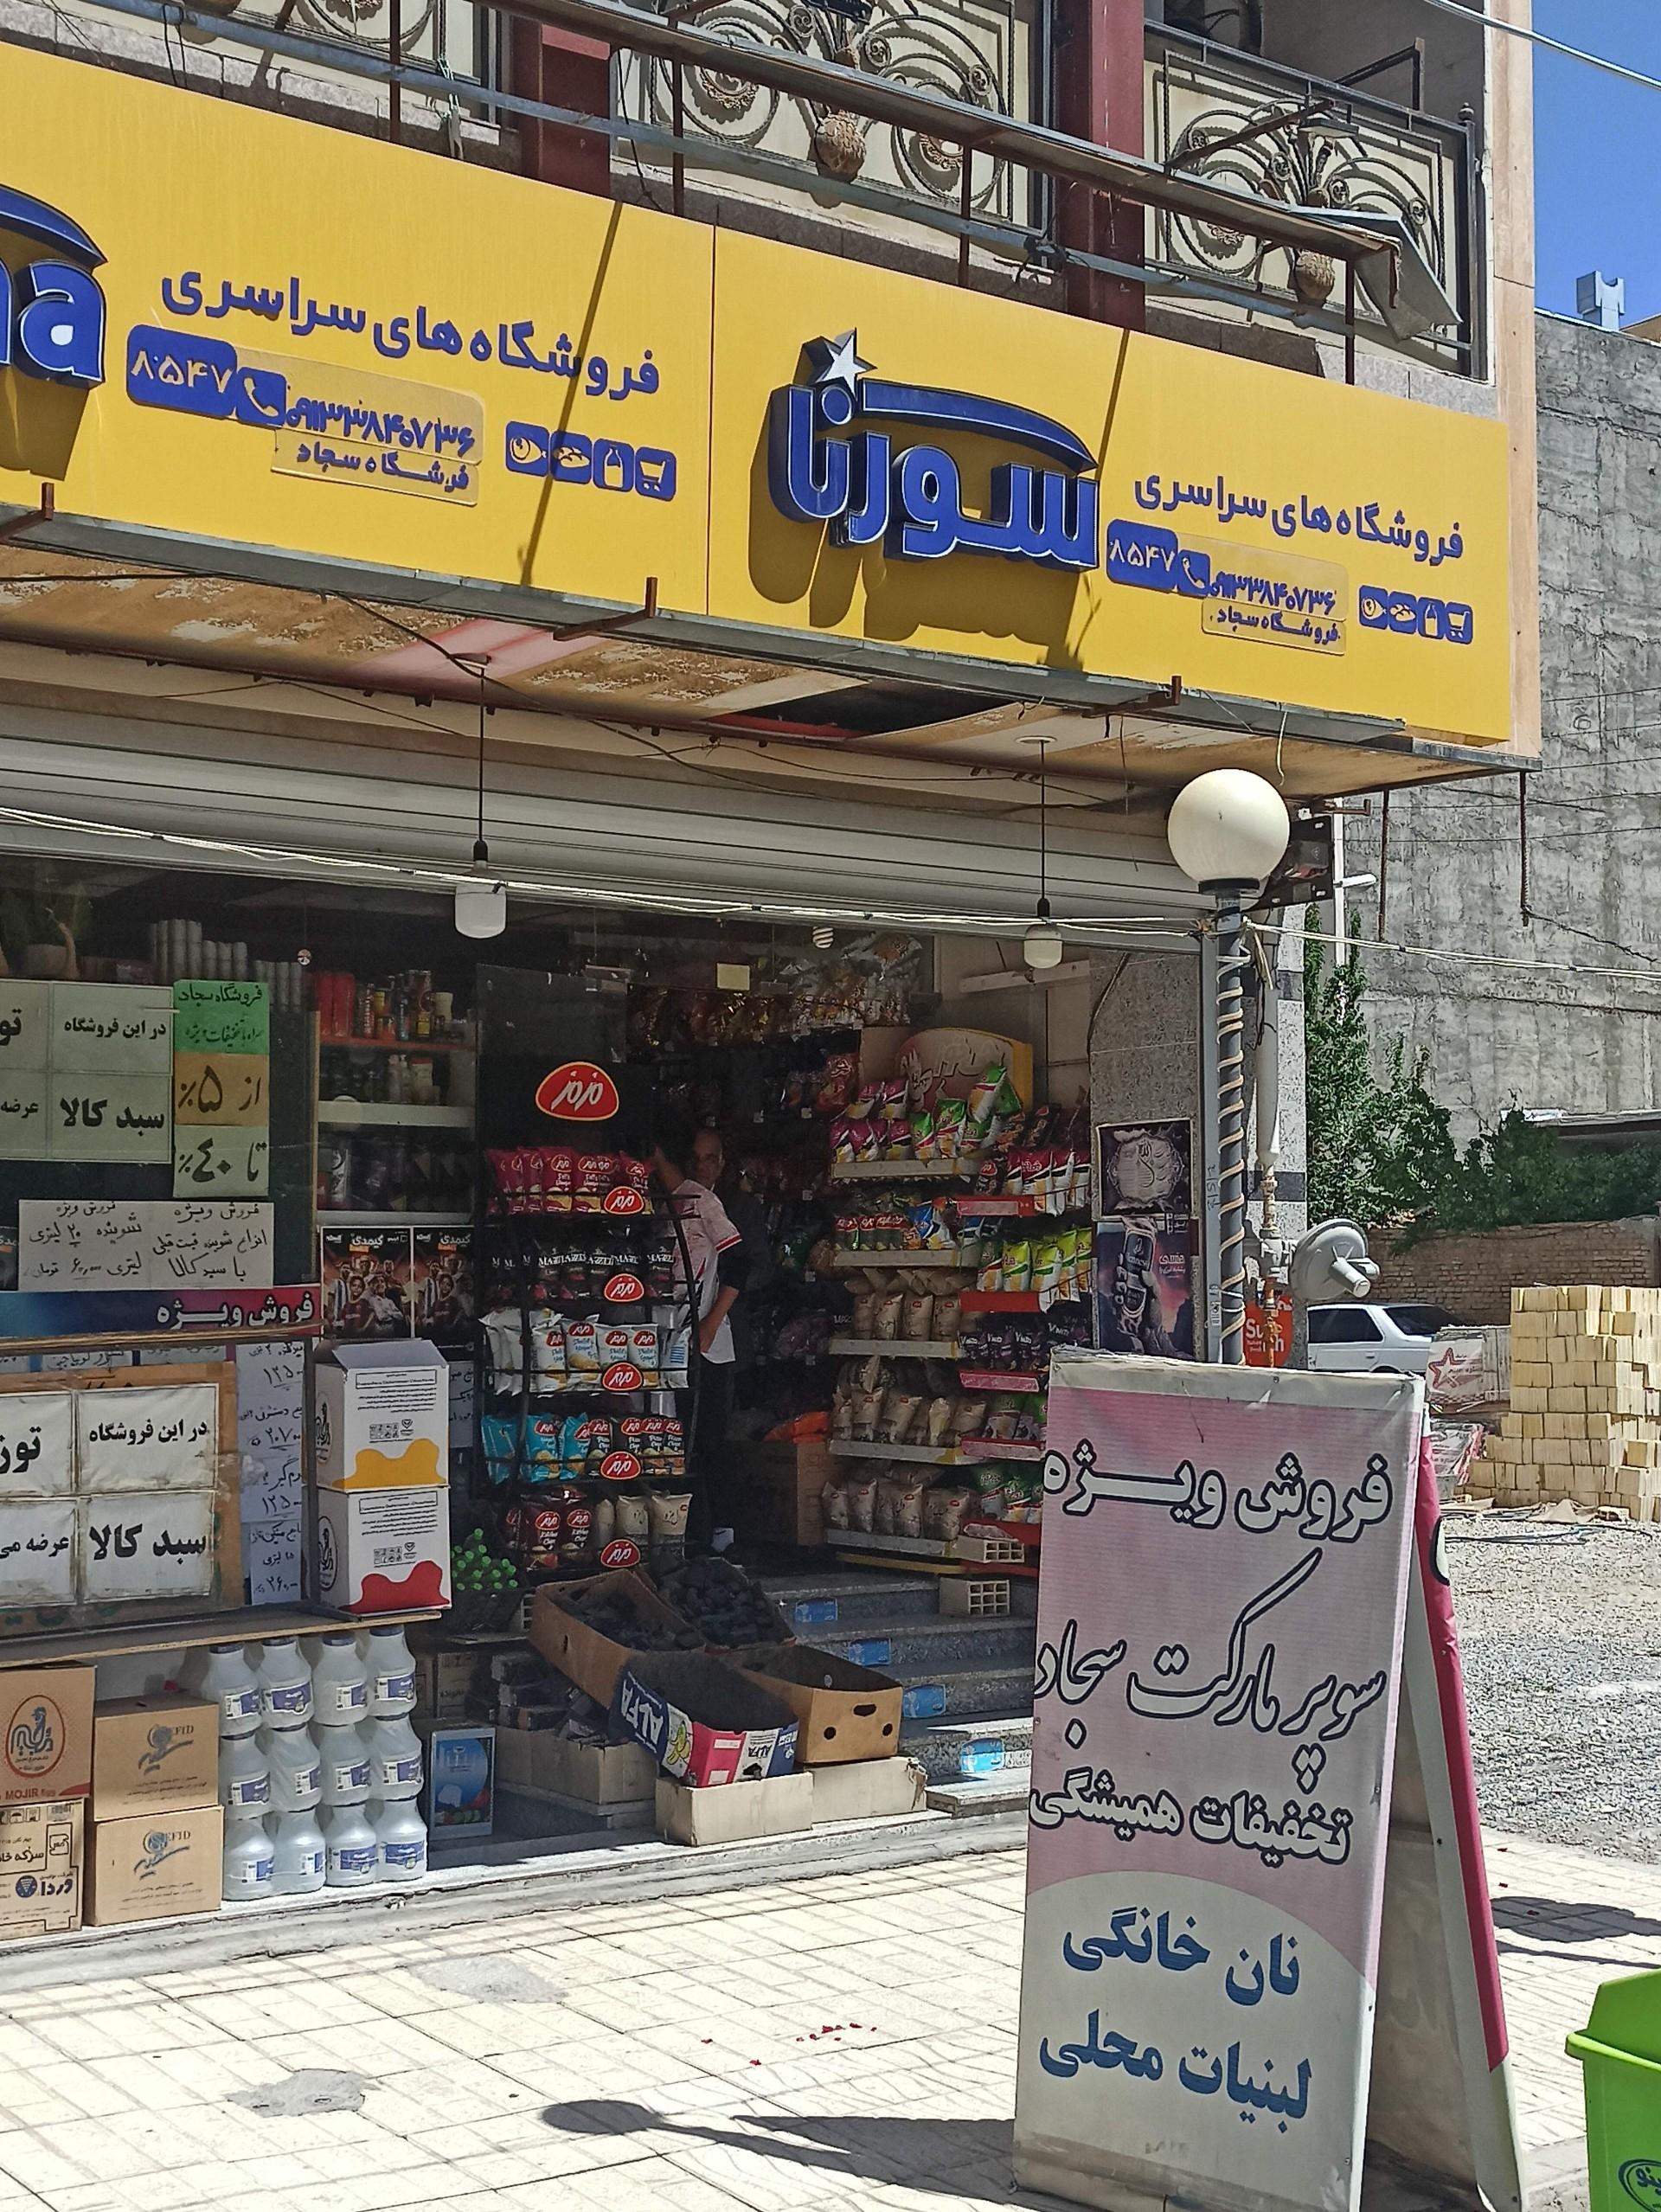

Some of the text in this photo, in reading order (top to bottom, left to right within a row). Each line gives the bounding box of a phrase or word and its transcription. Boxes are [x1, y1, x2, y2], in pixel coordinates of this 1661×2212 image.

[162, 272, 662, 400] فروشگاه های سراسری
[131, 349, 233, 394] ۸۵۴۷
[297, 440, 361, 472] سجاد
[783, 379, 1100, 573] سورنا
[1136, 473, 1465, 567] فروشگاه های سراسری
[1108, 539, 1176, 573] ۸۵۴۷
[1217, 606, 1341, 644] فروشگاه سجاد
[215, 983, 264, 1008] فروشگاه
[63, 1016, 167, 1040] در این فروشگاه
[0, 1099, 39, 1119] عرضه
[238, 1076, 261, 1112] از
[550, 1069, 605, 1112] مزمز
[59, 1096, 165, 1137] سبد کالا
[247, 1141, 267, 1182] تا
[56, 1200, 117, 1218] فروش ویژه
[174, 1200, 260, 1224] فروش ویژه
[156, 1291, 314, 1330] فروش ویژه
[88, 1416, 208, 1447] در این فروشگاه
[1042, 1438, 1395, 1546] فروش ویژه
[25, 1532, 69, 1558] عرضه
[88, 1523, 208, 1566] سبد کالا
[1034, 1547, 1388, 1793] سوپر مارکت سجاد
[5, 1787, 38, 1799] MOJIR
[1027, 1766, 1354, 1867] تخفیفات همیشگی
[1063, 1907, 1300, 2007] نان خانگی
[1039, 2009, 1313, 2134] لبنیات محلی
